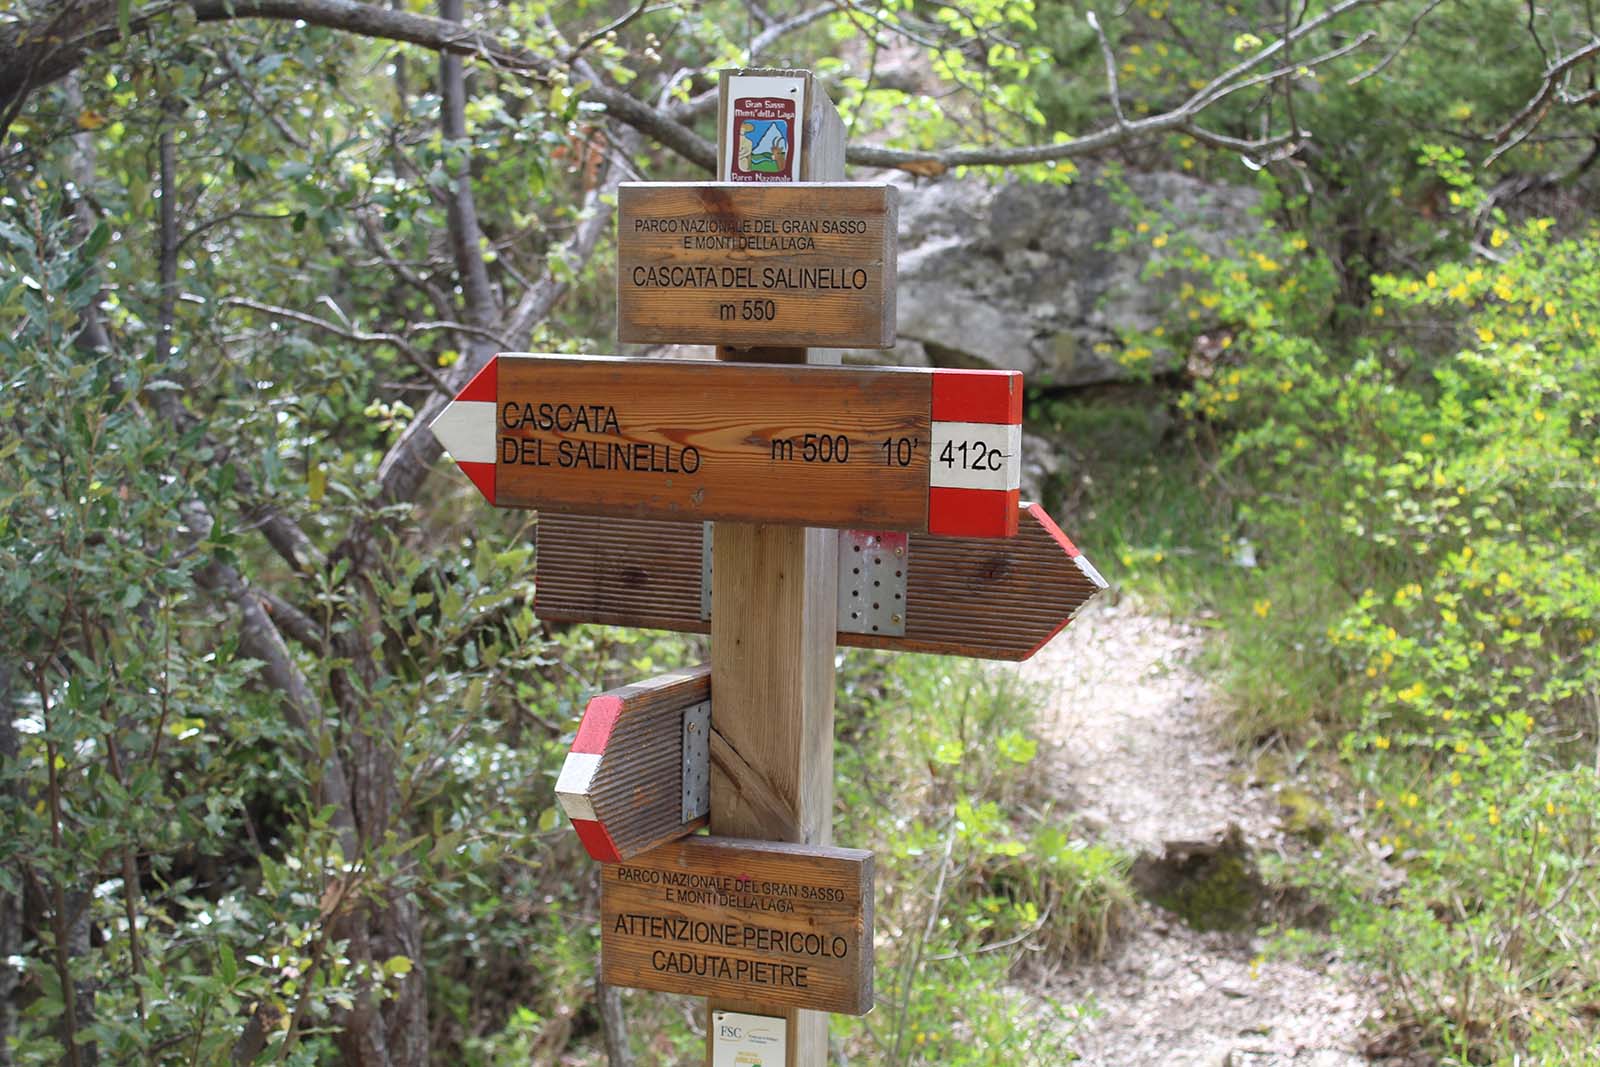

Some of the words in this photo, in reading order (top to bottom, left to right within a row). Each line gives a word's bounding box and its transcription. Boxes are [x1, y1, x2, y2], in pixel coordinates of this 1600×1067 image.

[745, 100, 762, 109] Gran
[635, 219, 677, 233] PARCO
[681, 219, 749, 233] NAZIONALE
[754, 220, 778, 233] DEL
[783, 220, 818, 233] GRAN
[822, 220, 866, 234] SASSO
[684, 236, 692, 249] E
[696, 236, 738, 249] MONTI
[739, 237, 778, 250] DELLA
[782, 237, 816, 250] LAGA
[633, 266, 718, 288] CASCATA
[722, 268, 759, 288] DEL
[762, 267, 867, 290] SALINELLO
[720, 303, 736, 321] m
[742, 300, 776, 321] 550
[502, 402, 621, 434] CASCATA
[502, 437, 551, 466] DEL
[557, 440, 700, 474] SALINELLO
[772, 438, 793, 461] m
[803, 434, 849, 463] 500
[939, 439, 1002, 471] 412c
[618, 868, 660, 884] PARCO
[663, 871, 731, 891] NAZIONALE
[735, 879, 759, 894] DEL
[762, 882, 798, 897] GRAN
[801, 886, 845, 902] SASSO
[666, 888, 674, 901] E
[678, 890, 718, 905] MONTI
[719, 894, 759, 911] DELLA
[761, 898, 795, 913] LAGA
[614, 914, 738, 948] ATTENZIONE
[743, 927, 848, 959] PERICOLO
[652, 950, 733, 980] CADUTA
[736, 959, 809, 988] PIETRE
[720, 1026, 742, 1039] FSC
